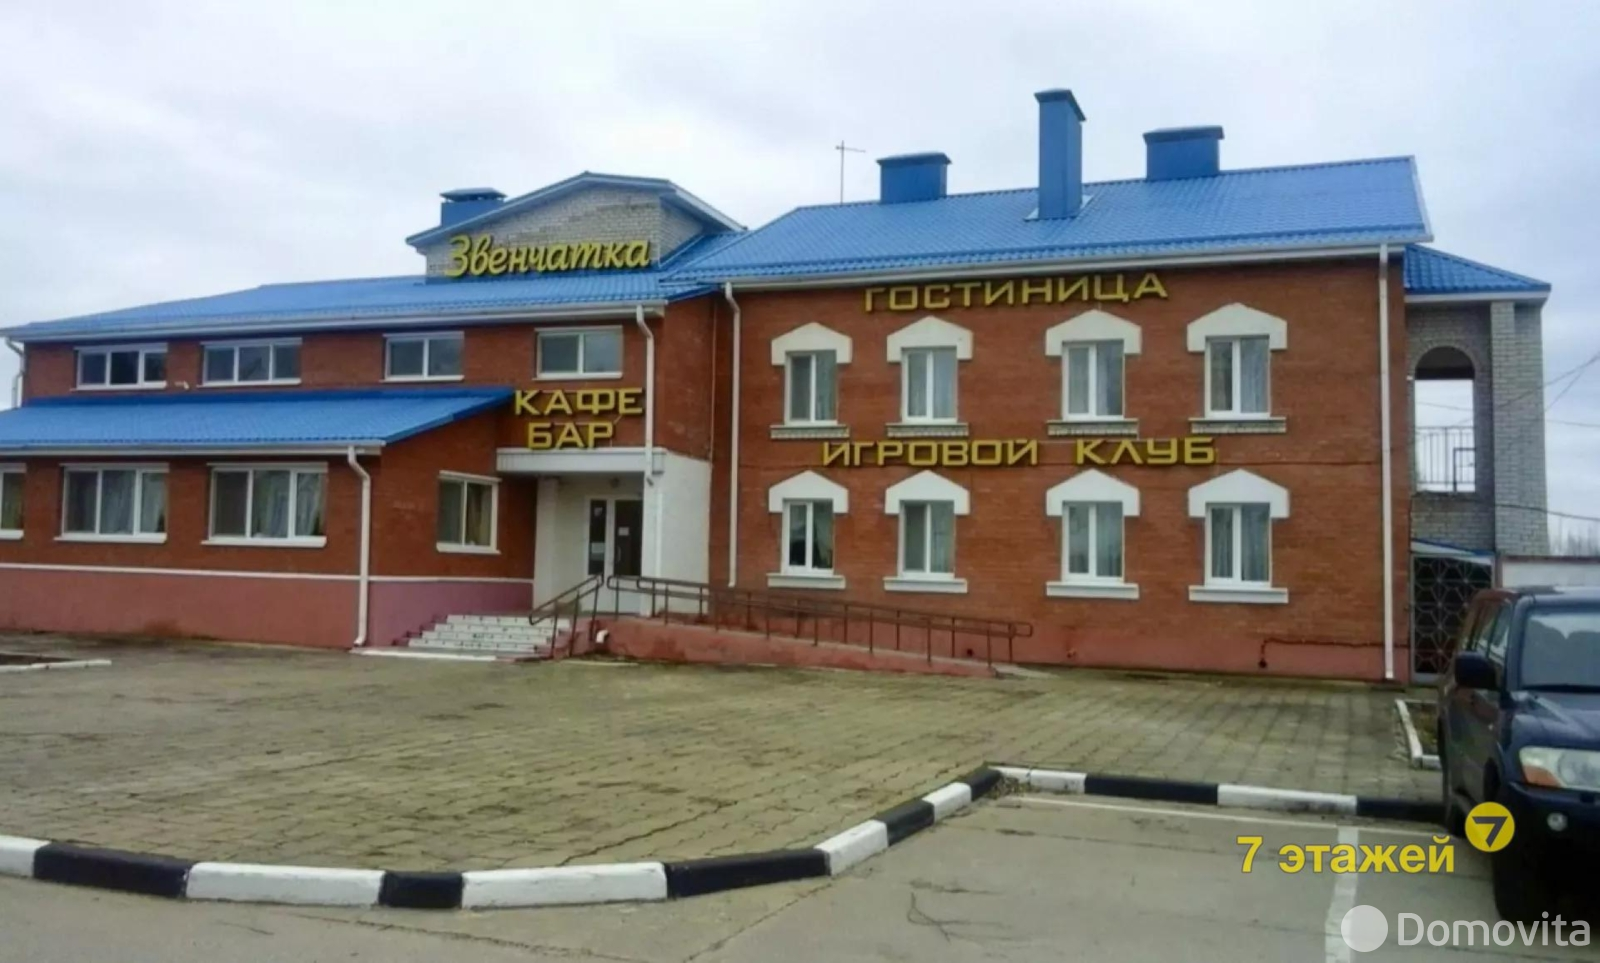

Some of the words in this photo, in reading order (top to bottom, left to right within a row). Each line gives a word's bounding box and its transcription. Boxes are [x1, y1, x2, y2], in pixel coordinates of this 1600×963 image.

[445, 233, 651, 278] Звенчатка
[864, 273, 1168, 312] ГОСТИНИЦА
[514, 387, 644, 416] КАФЕ
[527, 421, 614, 449] БАР
[822, 439, 1039, 467] ИГРОВОЙ
[1075, 437, 1219, 465] КЛУБ
